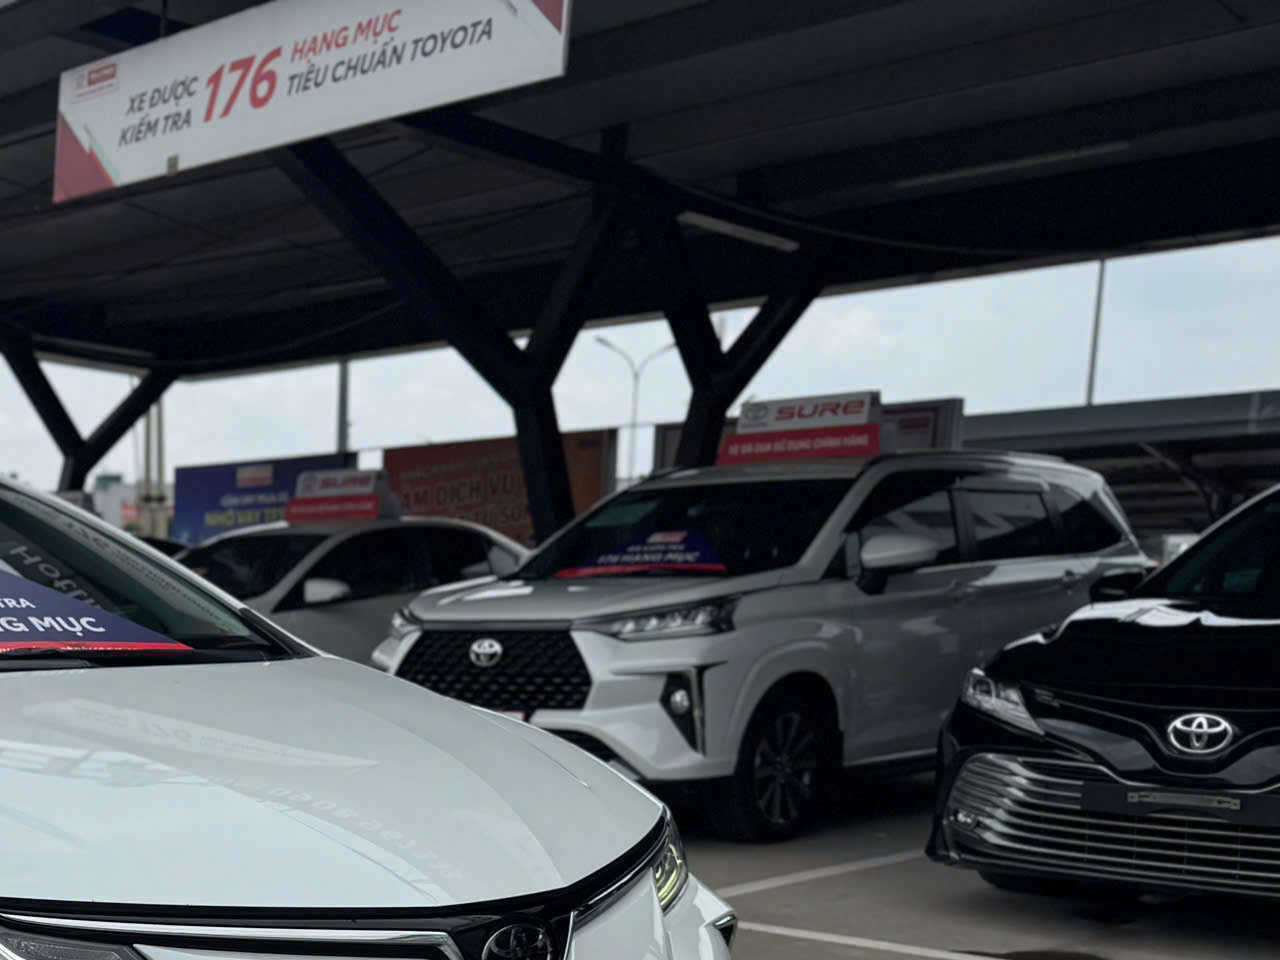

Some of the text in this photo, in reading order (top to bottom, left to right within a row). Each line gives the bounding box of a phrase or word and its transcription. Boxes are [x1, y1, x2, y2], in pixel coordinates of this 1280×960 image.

[287, 17, 493, 96] TIÊU CHUẨN TOYOTA
[290, 9, 403, 64] HẠNG MỤC
[126, 91, 148, 116] XE
[148, 76, 199, 108] ĐƯỢC
[203, 46, 282, 123] 176
[118, 109, 193, 148] KIỂM TRA
[28, 616, 106, 638] MỤC
